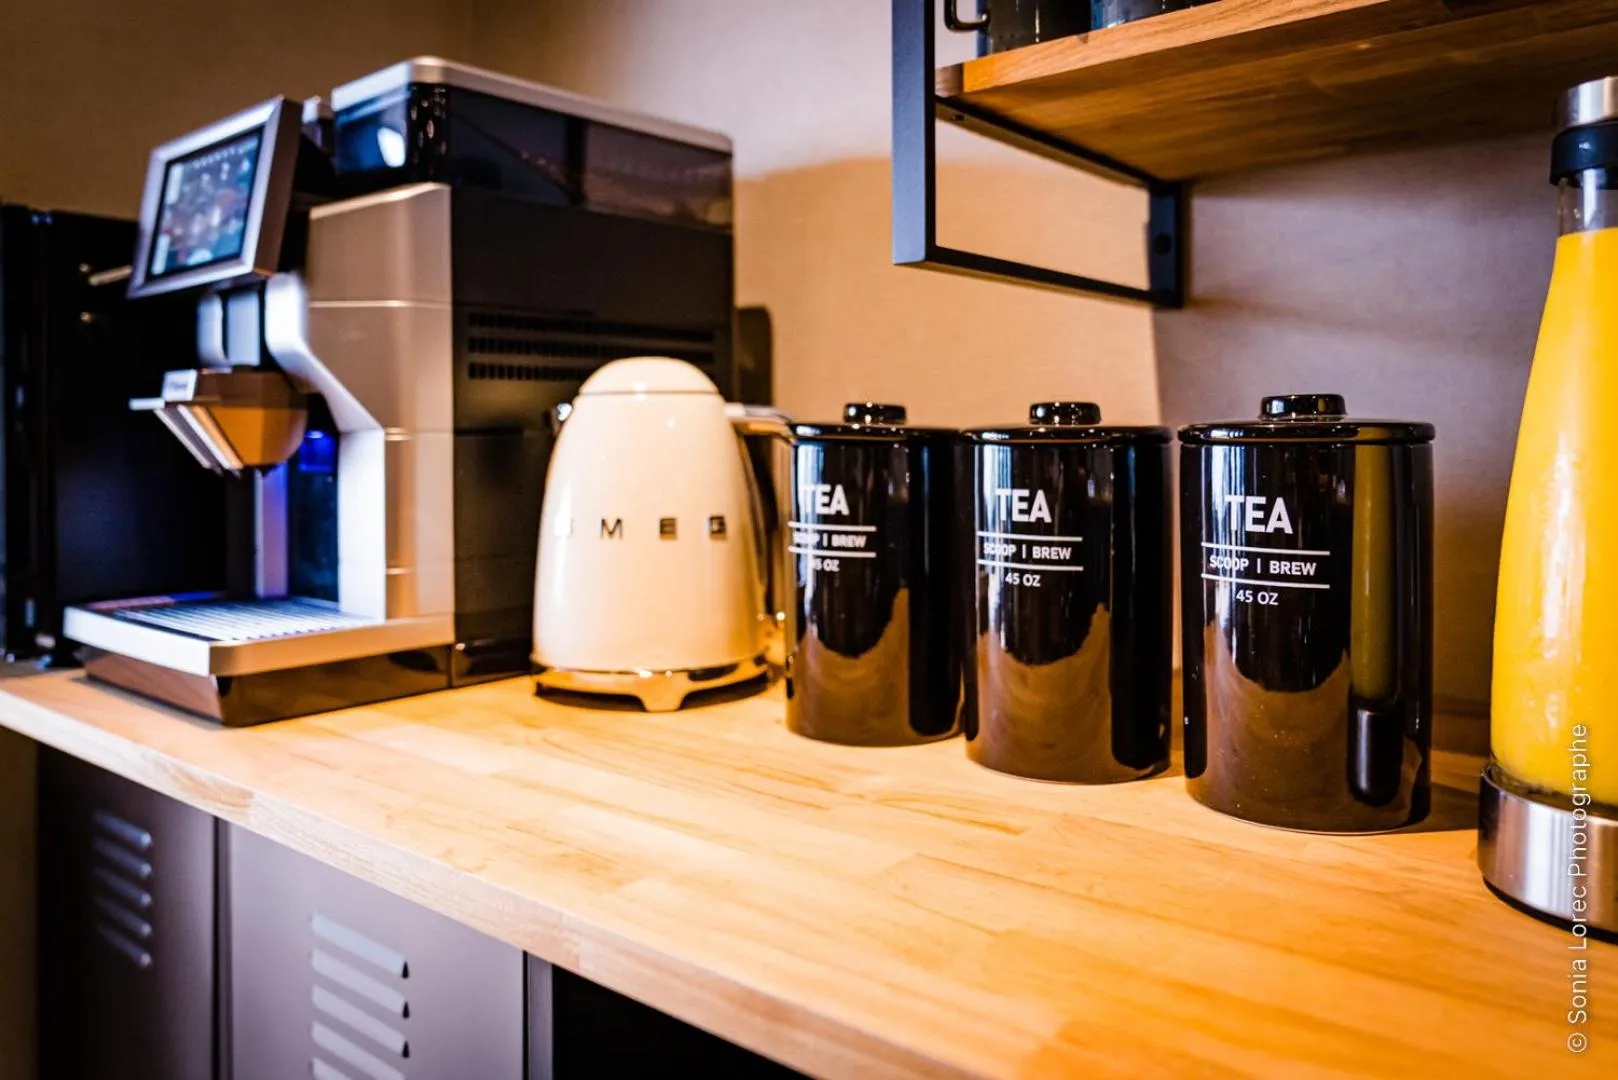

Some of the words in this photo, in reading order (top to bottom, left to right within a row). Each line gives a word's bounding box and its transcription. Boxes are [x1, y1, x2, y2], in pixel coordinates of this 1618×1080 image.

[802, 483, 850, 516] TEA
[996, 488, 1052, 523] TEA
[1225, 495, 1293, 535] TEA
[831, 534, 867, 548] BREW
[983, 542, 1017, 557] SCOOP
[1032, 546, 1072, 560] BREW
[1209, 555, 1249, 572] SCOOP
[1269, 560, 1317, 576] BREW
[1005, 572, 1020, 585] 45
[1022, 574, 1041, 587] OZ
[1236, 589, 1253, 603] 45
[1257, 591, 1279, 606] OZ
